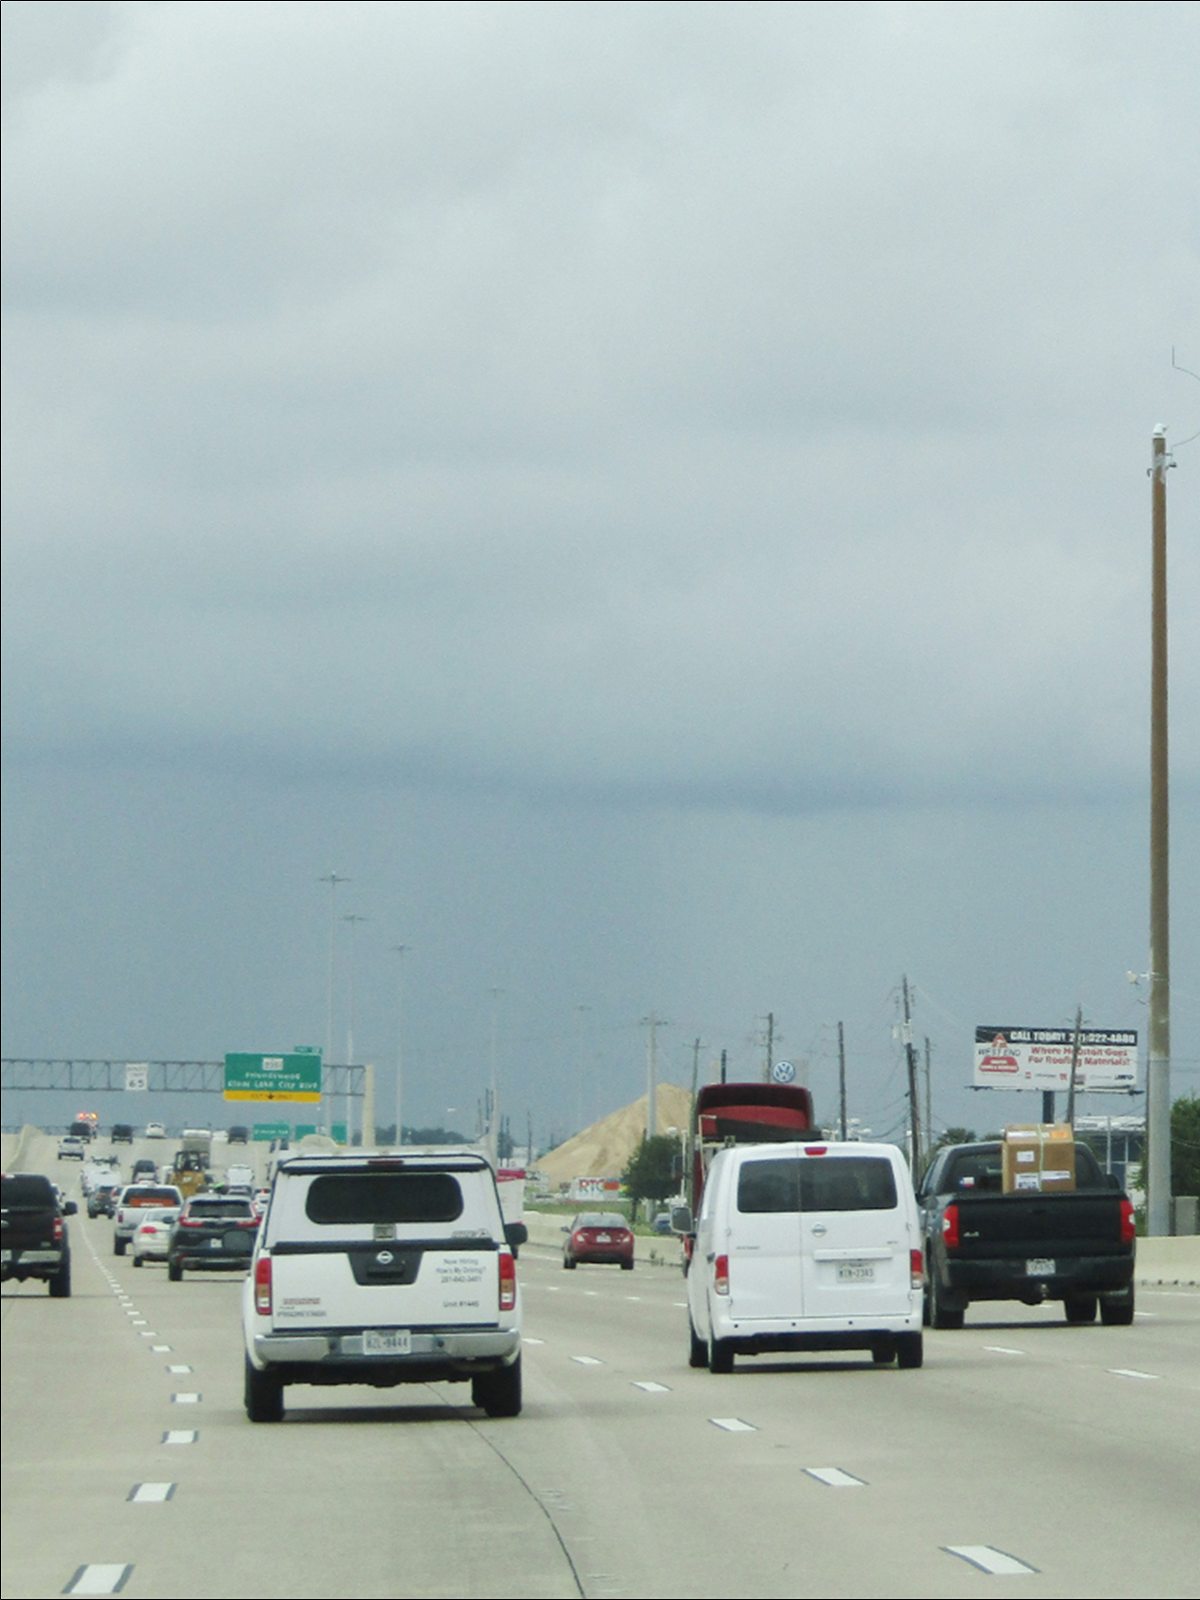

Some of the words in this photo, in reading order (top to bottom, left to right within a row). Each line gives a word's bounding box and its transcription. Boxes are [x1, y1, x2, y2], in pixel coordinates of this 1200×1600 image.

[1010, 1031, 1031, 1041] CALL
[978, 1048, 1002, 1057] WEST
[1031, 1047, 1061, 1055] Where
[1028, 1055, 1043, 1064] For
[1046, 1055, 1082, 1067] Roofig
